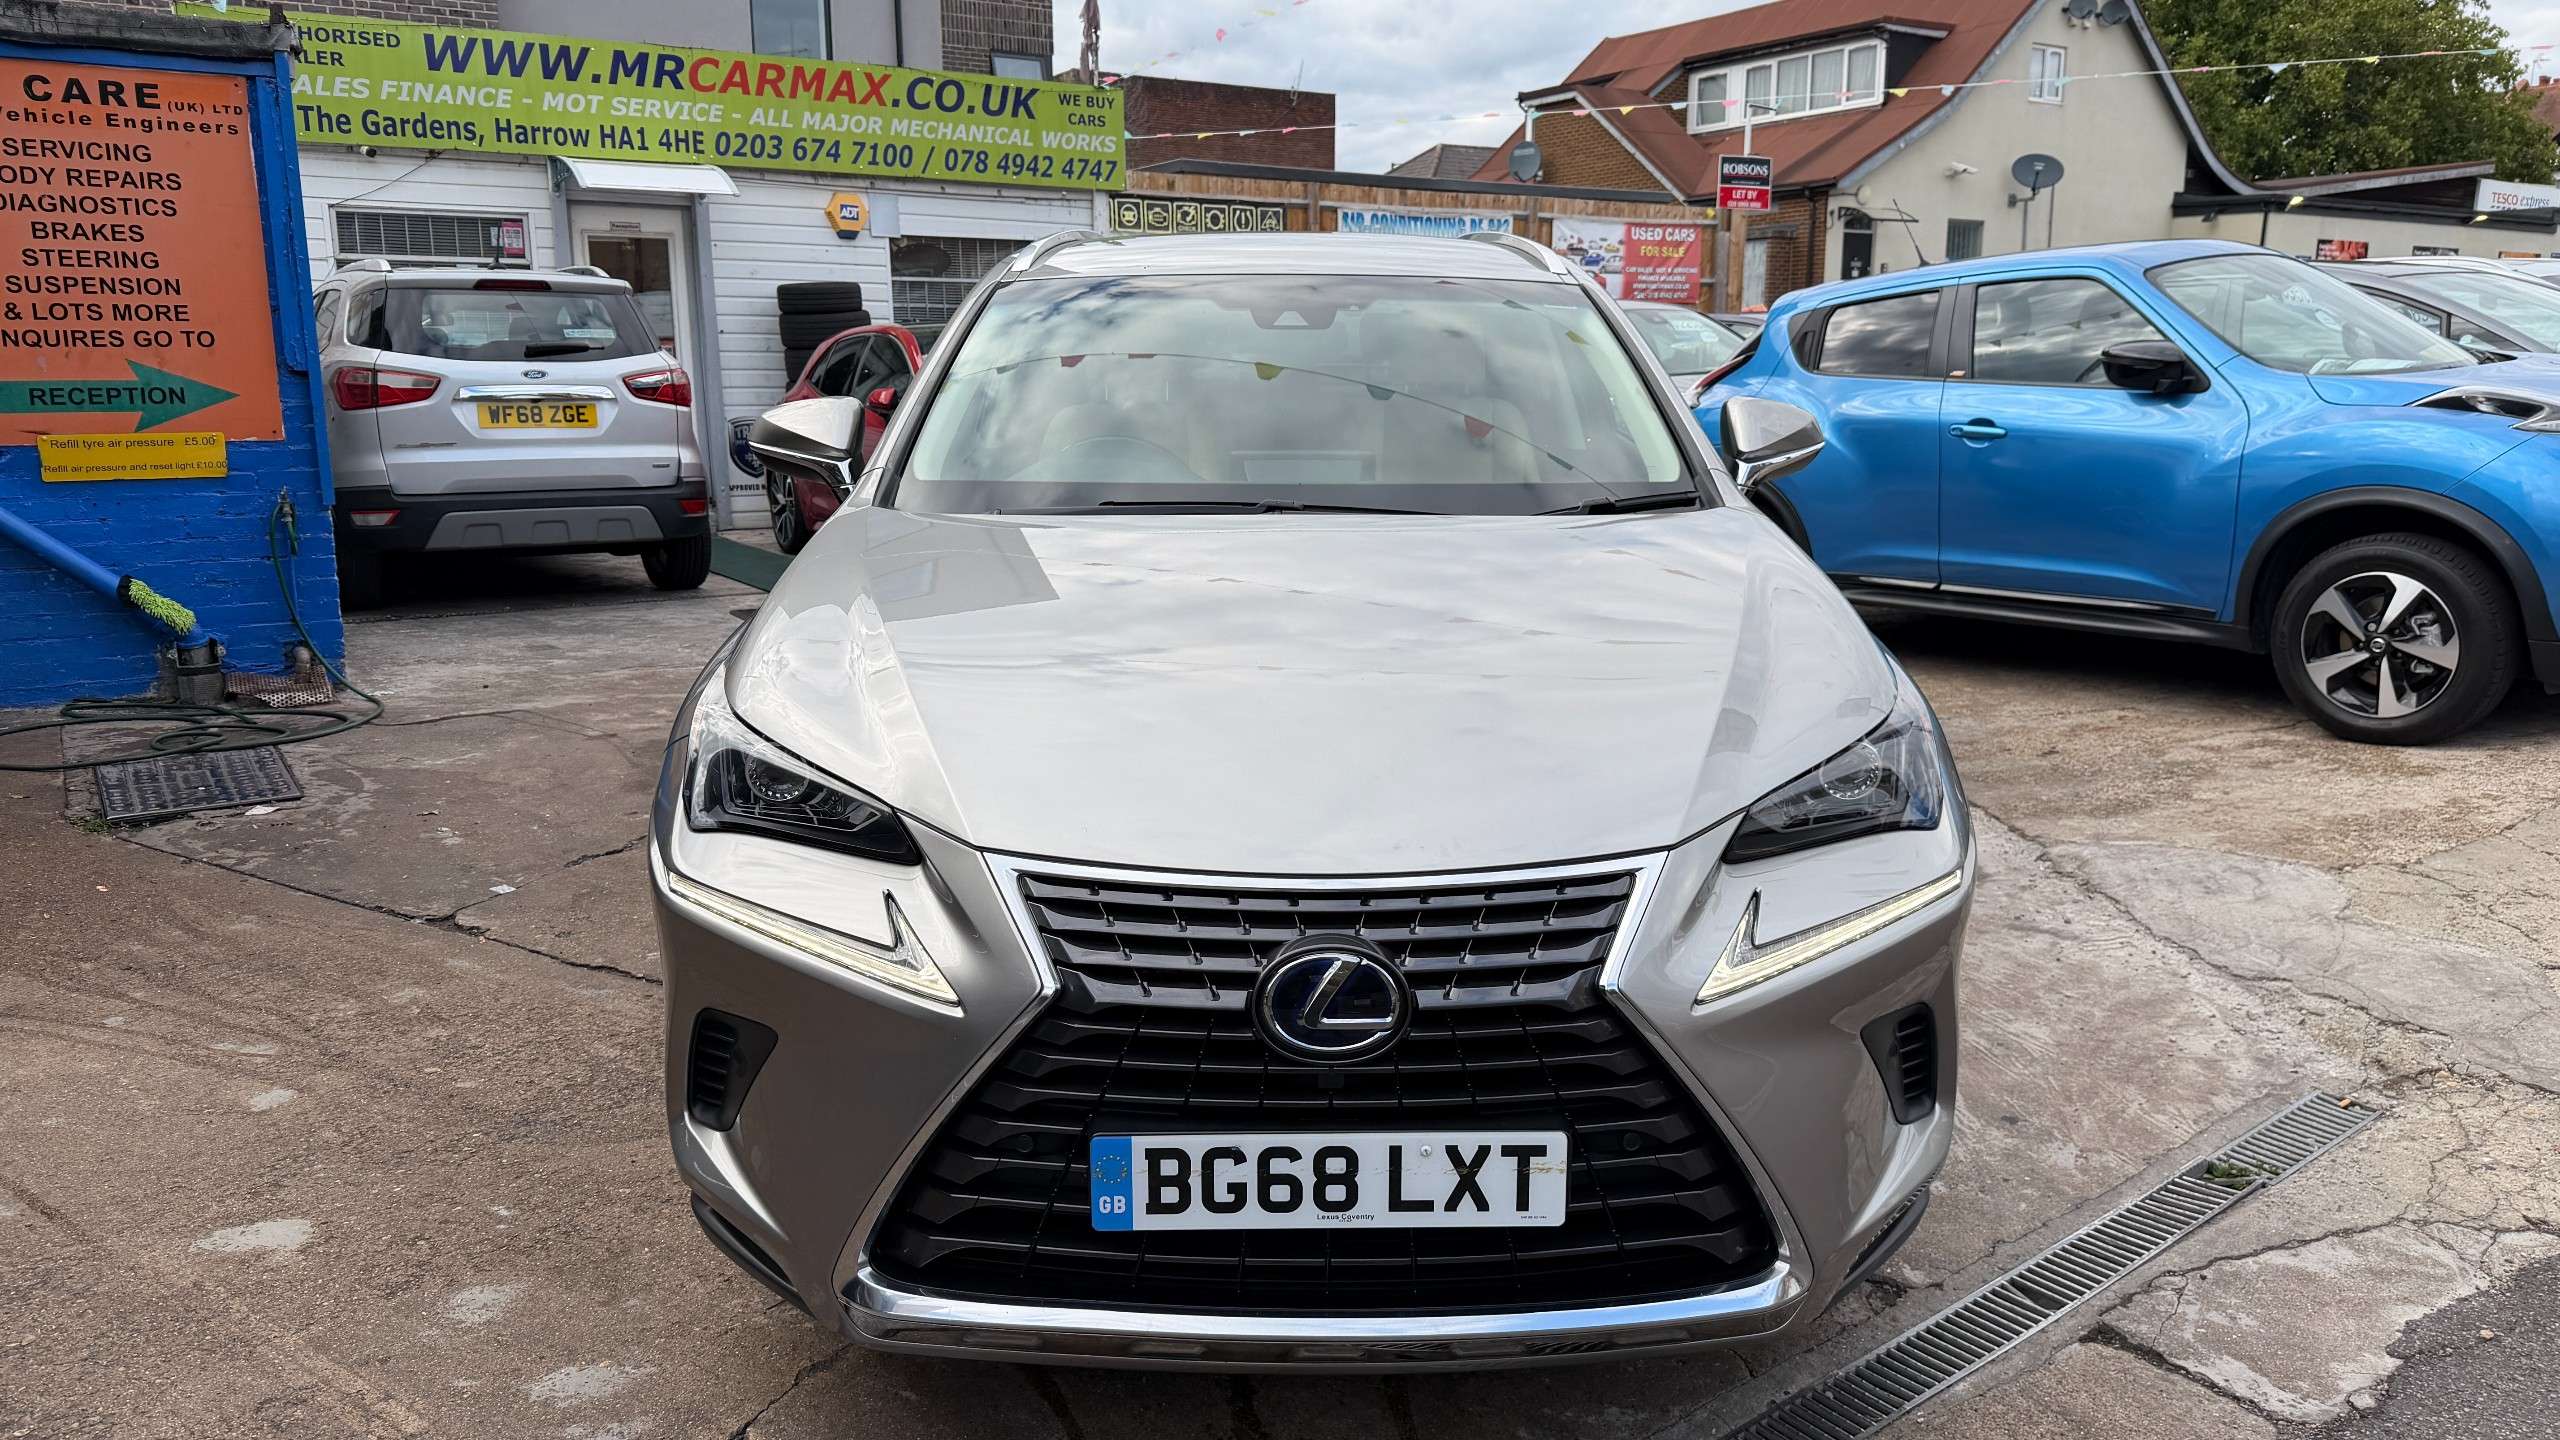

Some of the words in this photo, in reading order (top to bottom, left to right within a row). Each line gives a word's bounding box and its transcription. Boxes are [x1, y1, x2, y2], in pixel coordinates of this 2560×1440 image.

[298, 25, 401, 48] HORISED
[296, 49, 345, 66] LER
[423, 33, 1041, 120] WWW.MRCARMAX.CO.UK
[22, 74, 161, 110] CARE
[168, 101, 205, 115] (UK)
[213, 104, 243, 116] LTD
[1058, 93, 1081, 107] WE
[1086, 94, 1115, 110] BUY
[0, 107, 92, 126] ehicle
[106, 113, 239, 135] Engineers
[291, 73, 370, 99] ALES
[380, 78, 513, 109] FINANCE
[542, 91, 599, 115] MOT
[610, 96, 723, 123] SERVICE
[748, 107, 794, 129] ALL
[802, 111, 882, 136] MAJOR
[890, 118, 1033, 147] MECHANICAL
[1041, 130, 1117, 154] WORKS
[1067, 112, 1106, 128] CARS
[2, 137, 152, 163] SERVICING
[297, 105, 352, 135] The
[362, 109, 485, 147] Gardens,
[495, 117, 590, 147] Harrow
[600, 124, 649, 151] HA1
[658, 128, 705, 155] 4HE
[715, 131, 783, 160] 0203
[793, 136, 841, 164] 674
[852, 141, 914, 168] 7100
[922, 147, 936, 173] /
[945, 148, 989, 174] 078
[997, 153, 1053, 179] 4942
[1061, 158, 1118, 183] 4747
[0, 165, 56, 185] ODY
[66, 168, 182, 191] REPAIRS
[1723, 163, 1769, 176] ROBSONS
[1732, 190, 1747, 199] LET
[2492, 192, 2518, 206] TESCO
[841, 207, 859, 218] ADT
[31, 221, 145, 243] BRAKES
[1631, 226, 1663, 240] USED
[1665, 228, 1696, 242] CARS
[22, 249, 160, 270] STEERING
[1640, 245, 1660, 257] FOR
[1662, 246, 1686, 257] SALE
[5, 276, 181, 296] SUSPENSION
[4, 302, 23, 320] &
[32, 303, 103, 321] LOTS
[112, 304, 190, 322] MORE
[0, 329, 125, 348] NQUIRES
[133, 330, 173, 348] GO
[180, 330, 215, 348] TO
[29, 387, 186, 406] RECEPTION
[488, 406, 543, 424] WF68
[548, 405, 589, 423] ZGE
[50, 439, 79, 449] Refill
[83, 440, 104, 450] tyre
[108, 439, 121, 448] air
[125, 438, 174, 449] pressure
[184, 437, 215, 446] £5.00
[44, 465, 68, 473] Refill
[71, 465, 83, 473] air
[86, 464, 126, 473] pressure
[129, 462, 147, 471] and
[175, 461, 194, 470] light
[1144, 1145, 1359, 1215] BG68
[1388, 1144, 1548, 1213] LXT
[1099, 1196, 1126, 1213] GB
